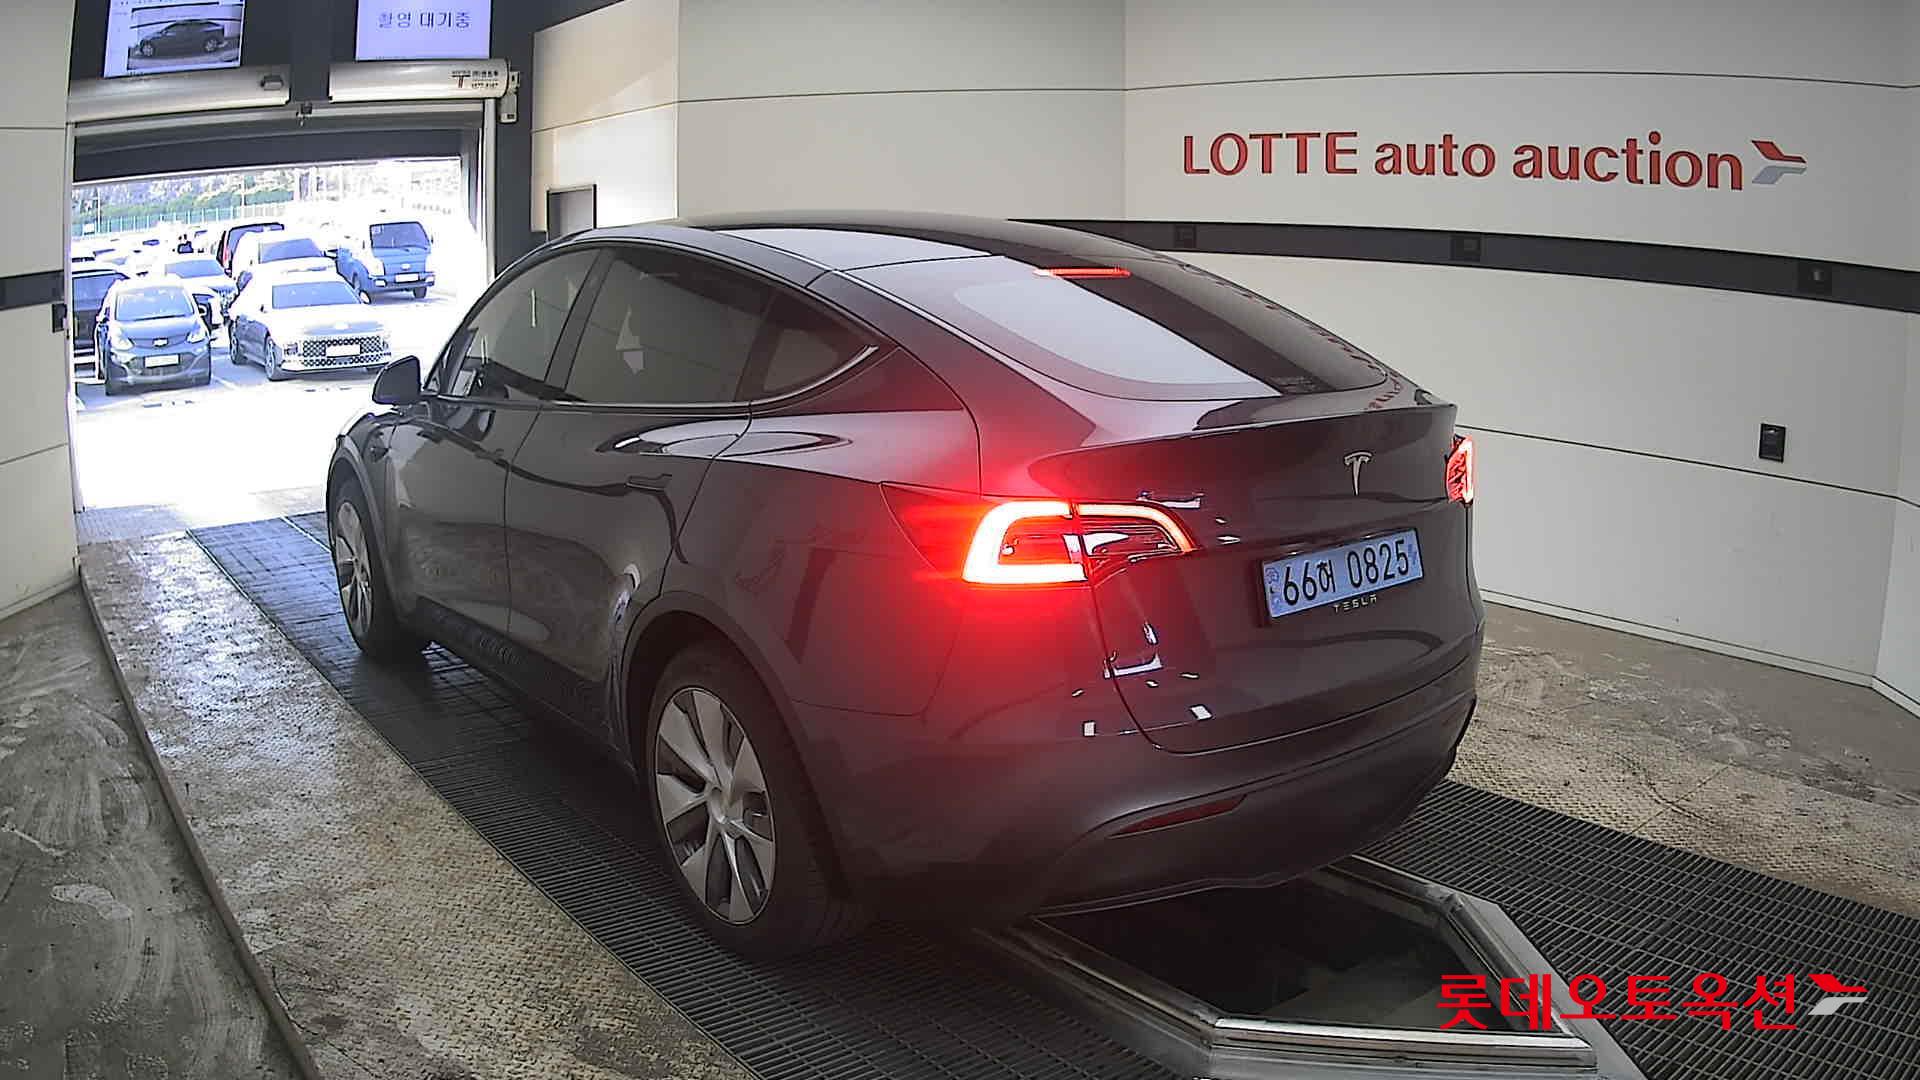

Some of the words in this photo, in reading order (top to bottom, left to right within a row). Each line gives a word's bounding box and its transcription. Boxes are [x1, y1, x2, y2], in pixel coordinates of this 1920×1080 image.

[419, 11, 472, 29] 대기중
[1183, 130, 1359, 176] LOTTE
[1374, 133, 1497, 178] auto
[1511, 131, 1743, 190] auction
[1346, 538, 1410, 589] 0825
[1332, 593, 1379, 614] TESLA
